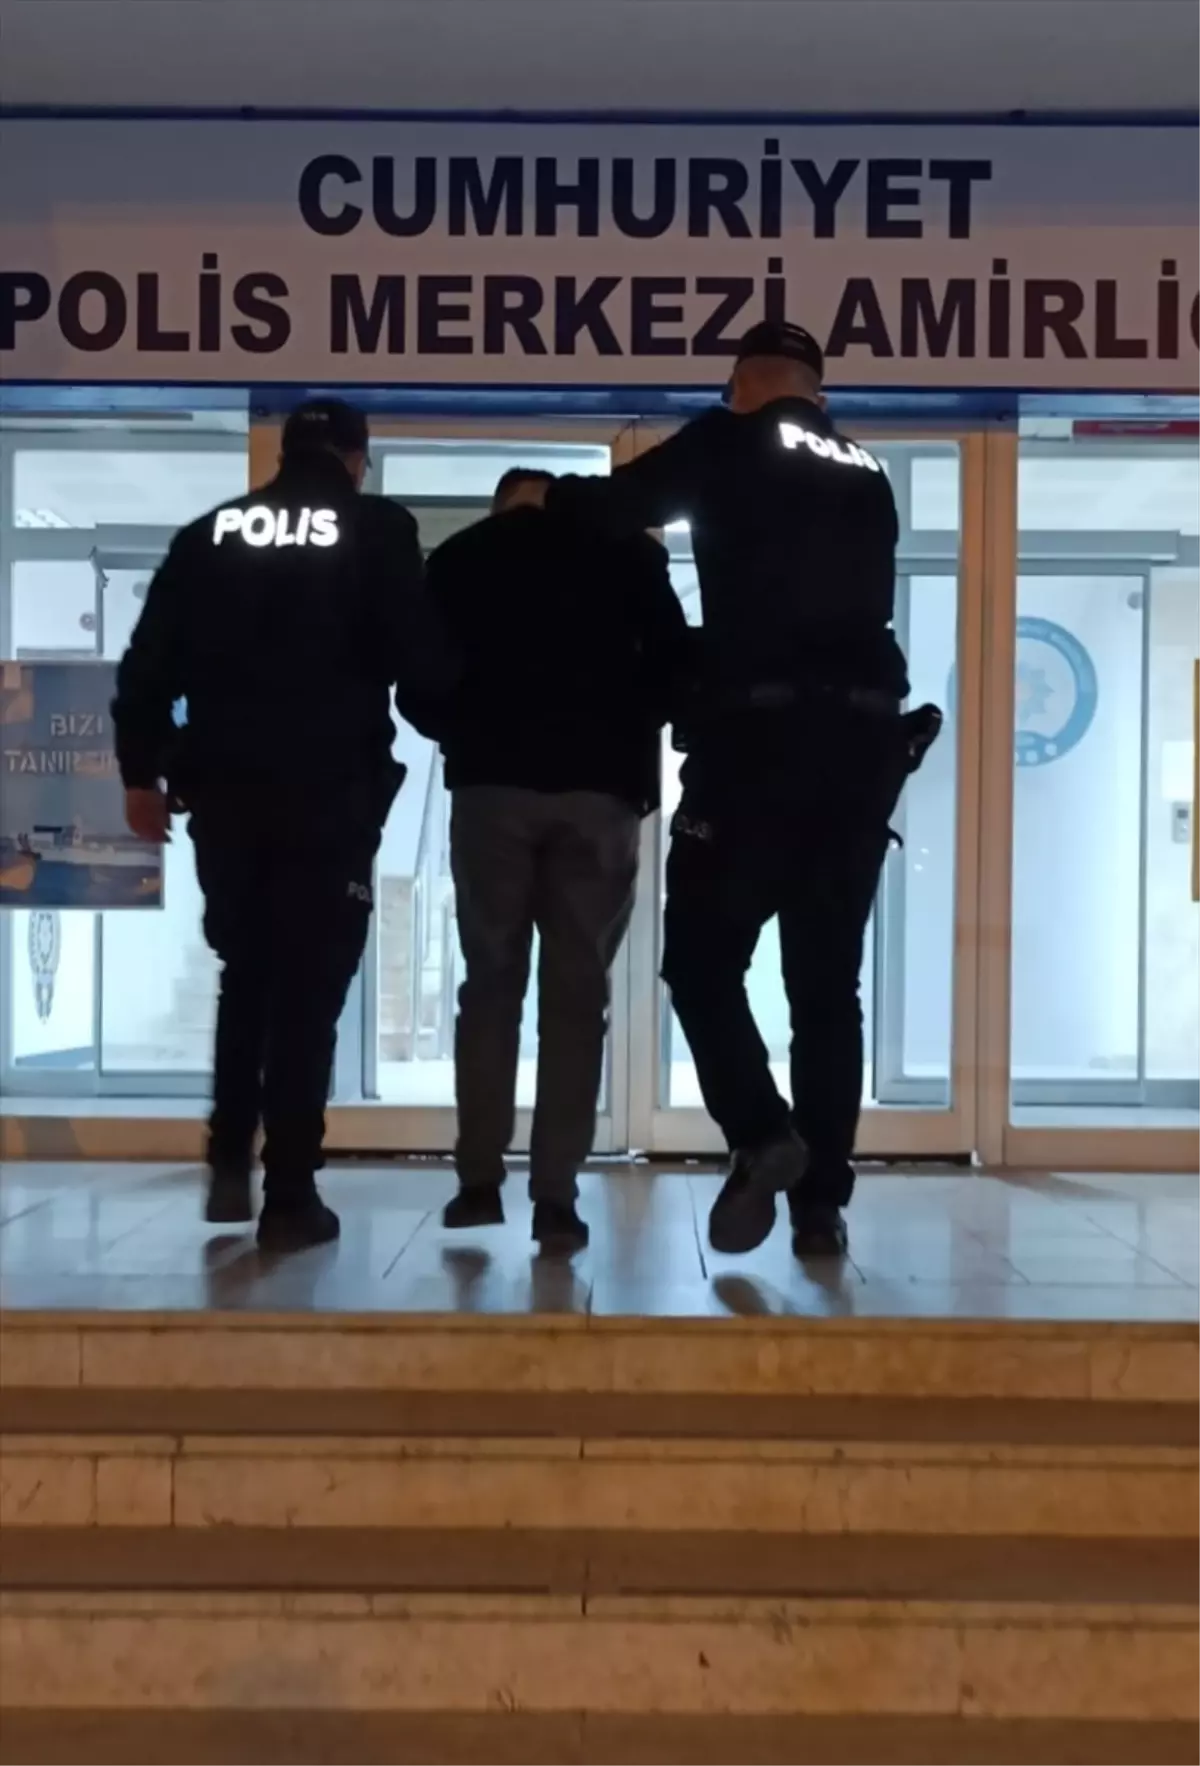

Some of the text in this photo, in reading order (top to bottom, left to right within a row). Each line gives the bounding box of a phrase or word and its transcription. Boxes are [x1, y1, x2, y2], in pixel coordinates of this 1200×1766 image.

[298, 138, 992, 239] CUMHURİYET
[0, 253, 1200, 360] POLİS MERKEZİ AMİRLİ
[212, 505, 339, 547] POLIS
